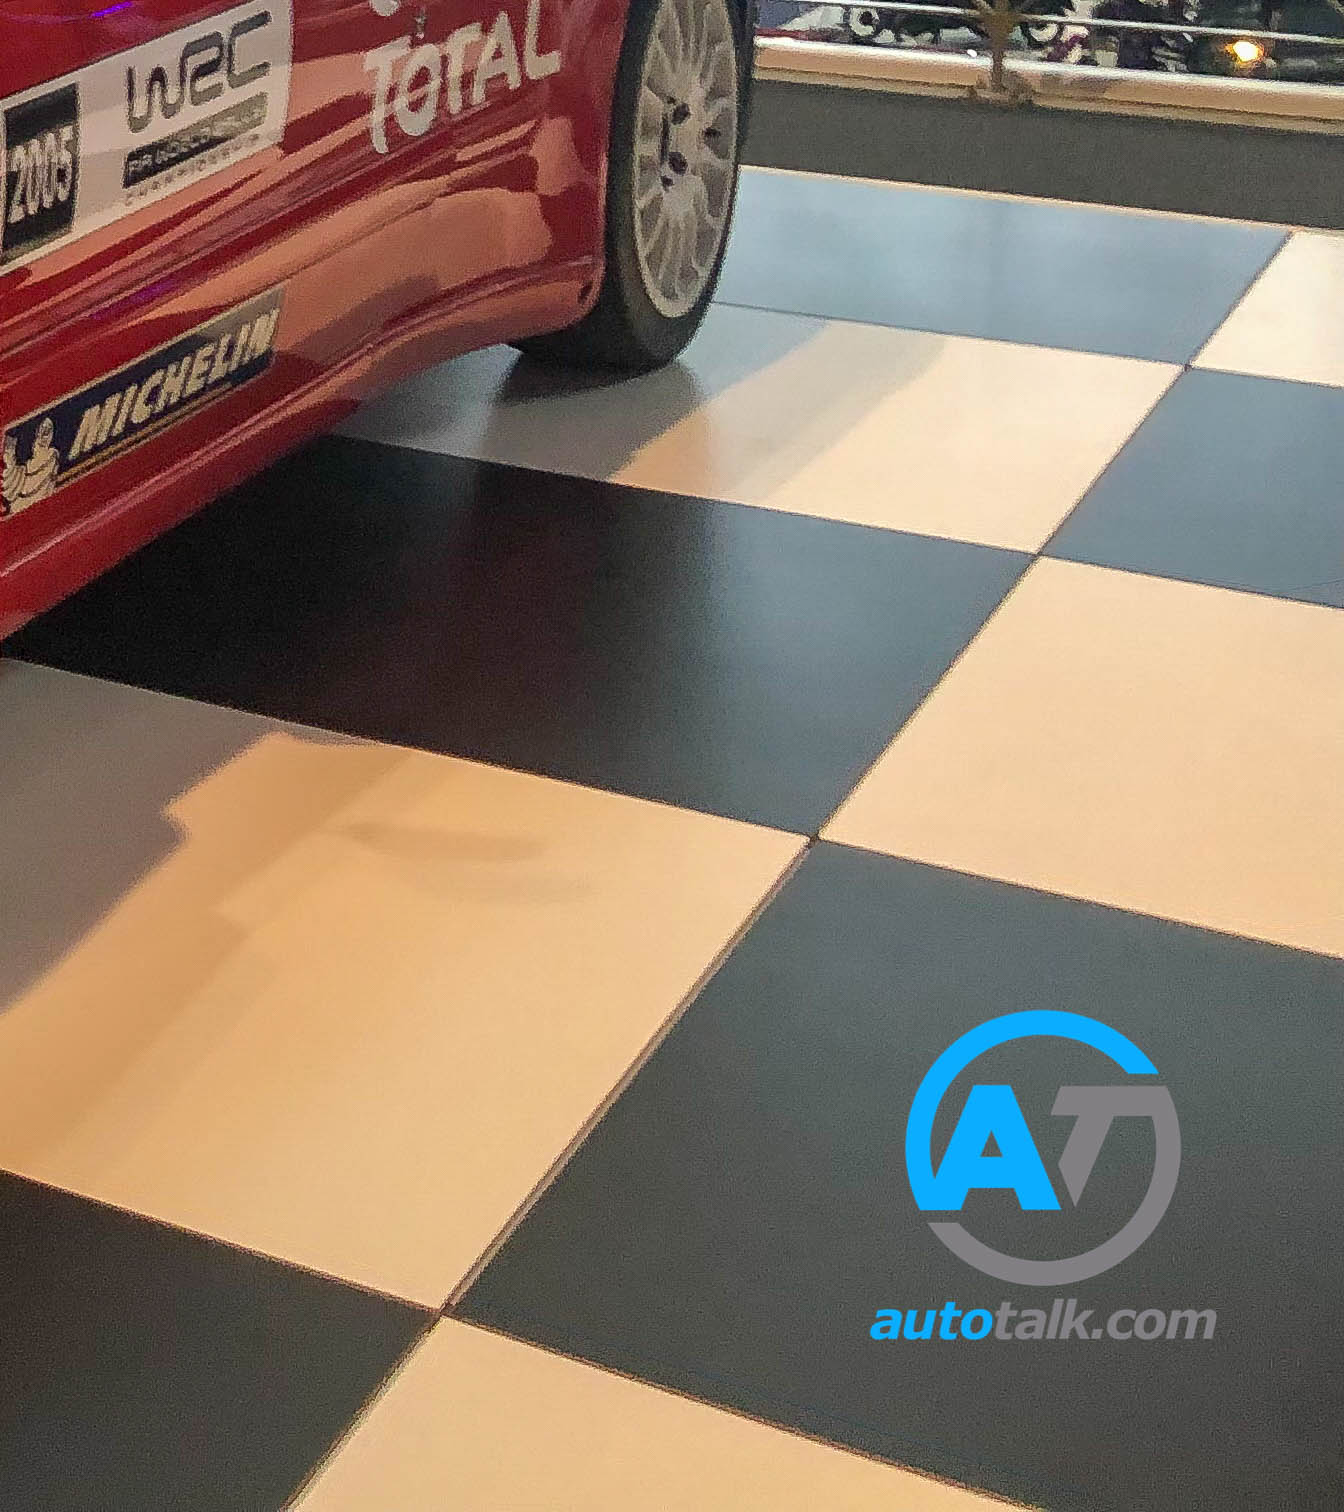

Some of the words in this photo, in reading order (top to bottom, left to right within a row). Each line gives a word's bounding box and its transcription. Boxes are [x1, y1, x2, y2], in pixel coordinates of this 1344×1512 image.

[126, 9, 273, 134] WRC
[7, 124, 79, 224] 2005
[66, 306, 281, 461] MICHELIN
